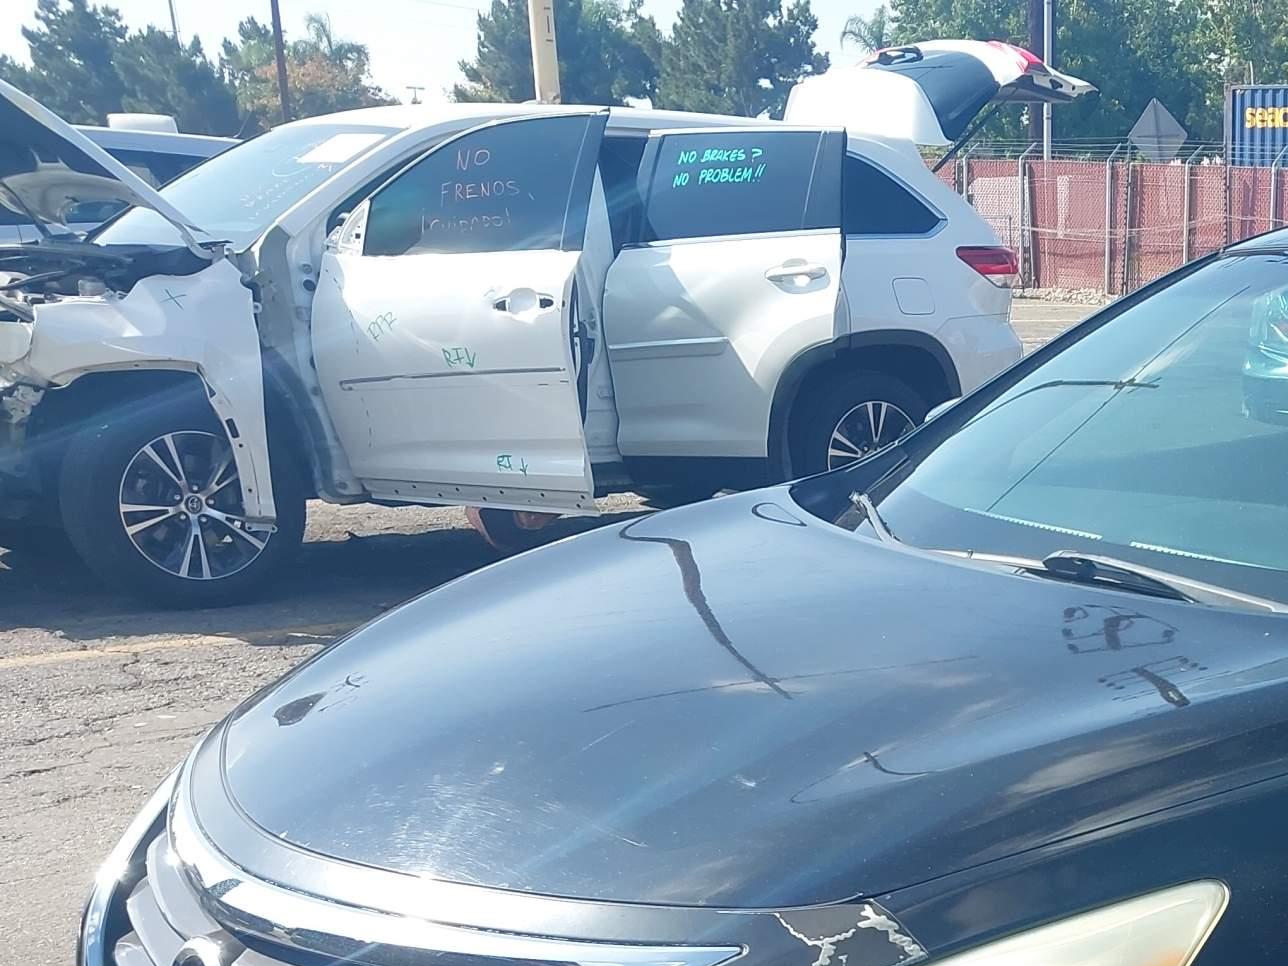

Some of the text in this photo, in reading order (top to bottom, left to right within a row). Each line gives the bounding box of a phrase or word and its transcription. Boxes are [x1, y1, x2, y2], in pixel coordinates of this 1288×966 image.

[456, 150, 491, 171] NO
[678, 151, 697, 165] NO
[701, 148, 747, 163] BRAKES
[672, 172, 690, 188] NO
